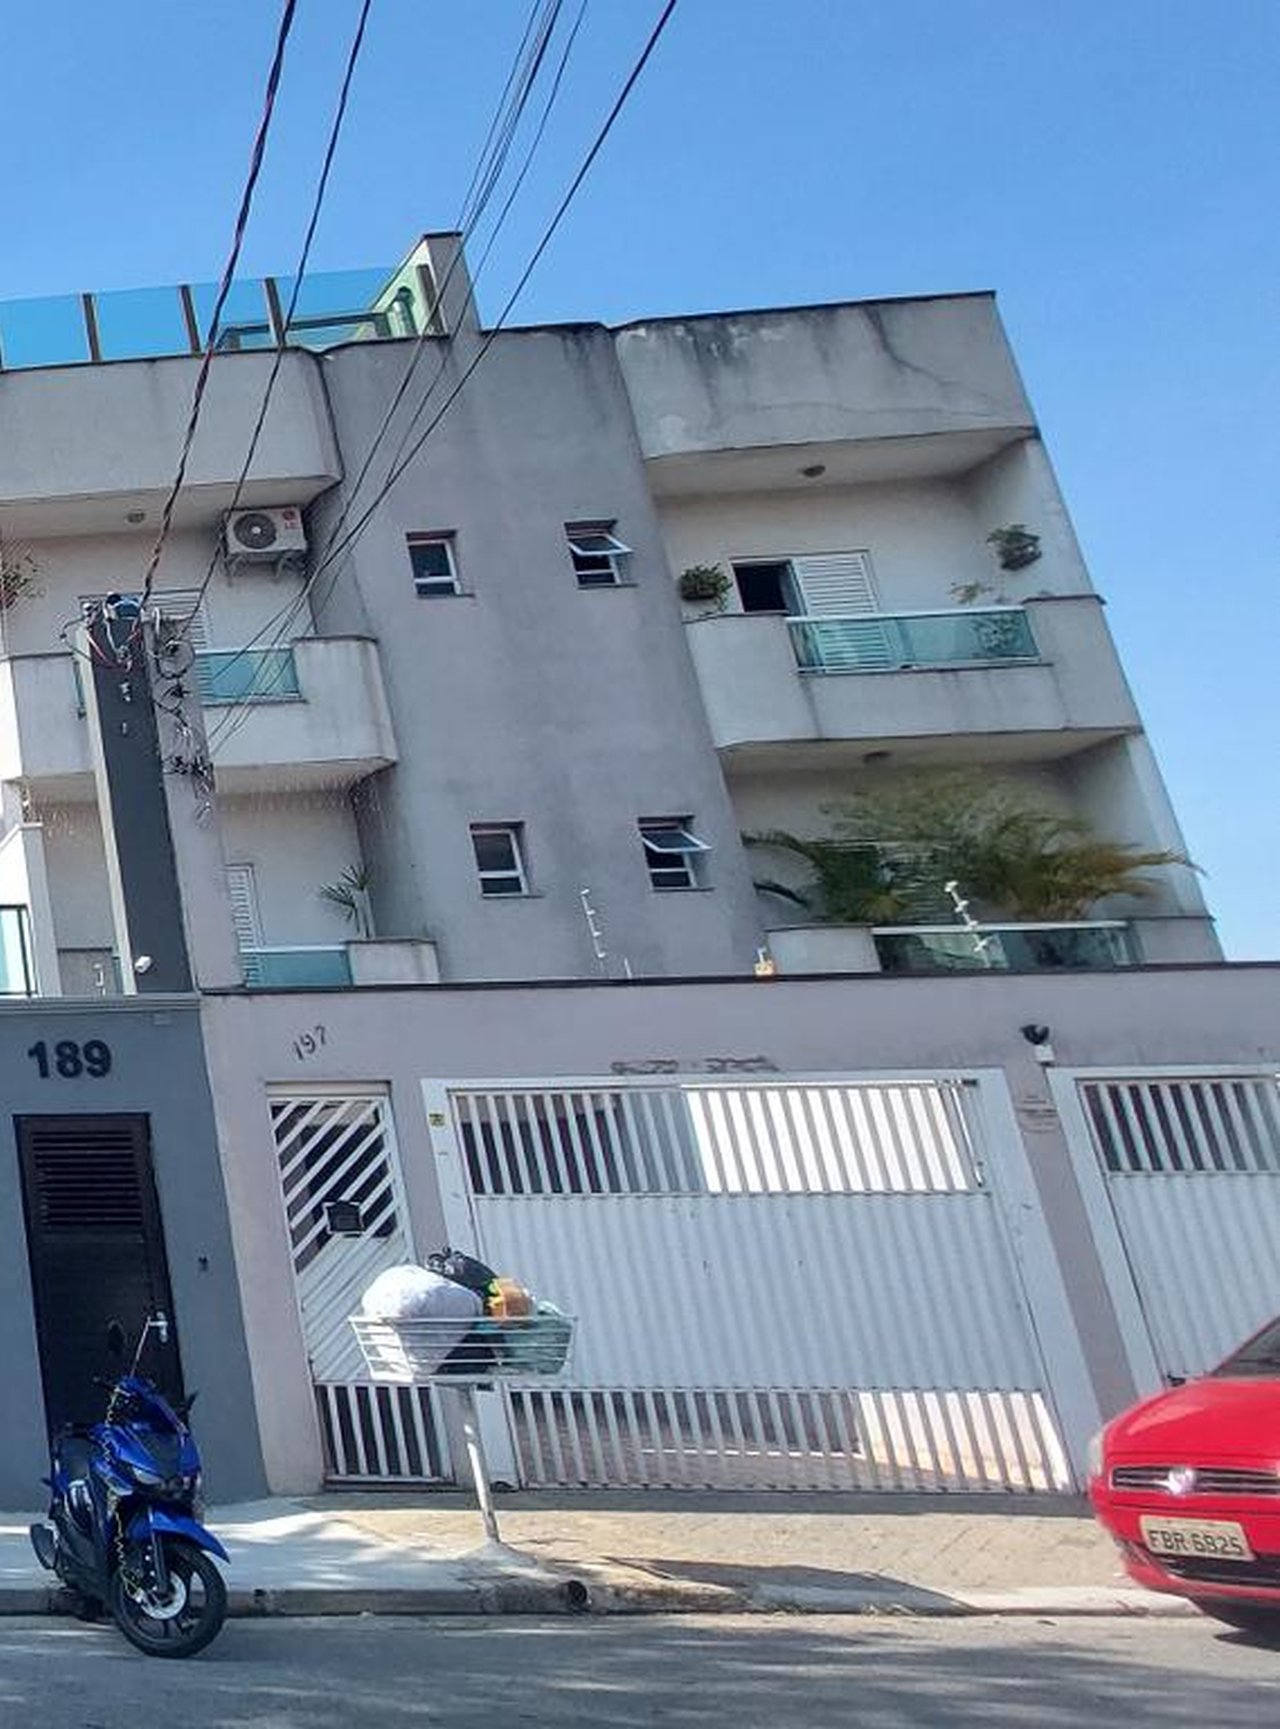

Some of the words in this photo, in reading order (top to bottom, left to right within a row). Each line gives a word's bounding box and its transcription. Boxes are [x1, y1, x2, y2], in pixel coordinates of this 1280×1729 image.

[27, 1039, 112, 1079] 189
[292, 1024, 327, 1060] 197
[1149, 1530, 1189, 1552] FBR
